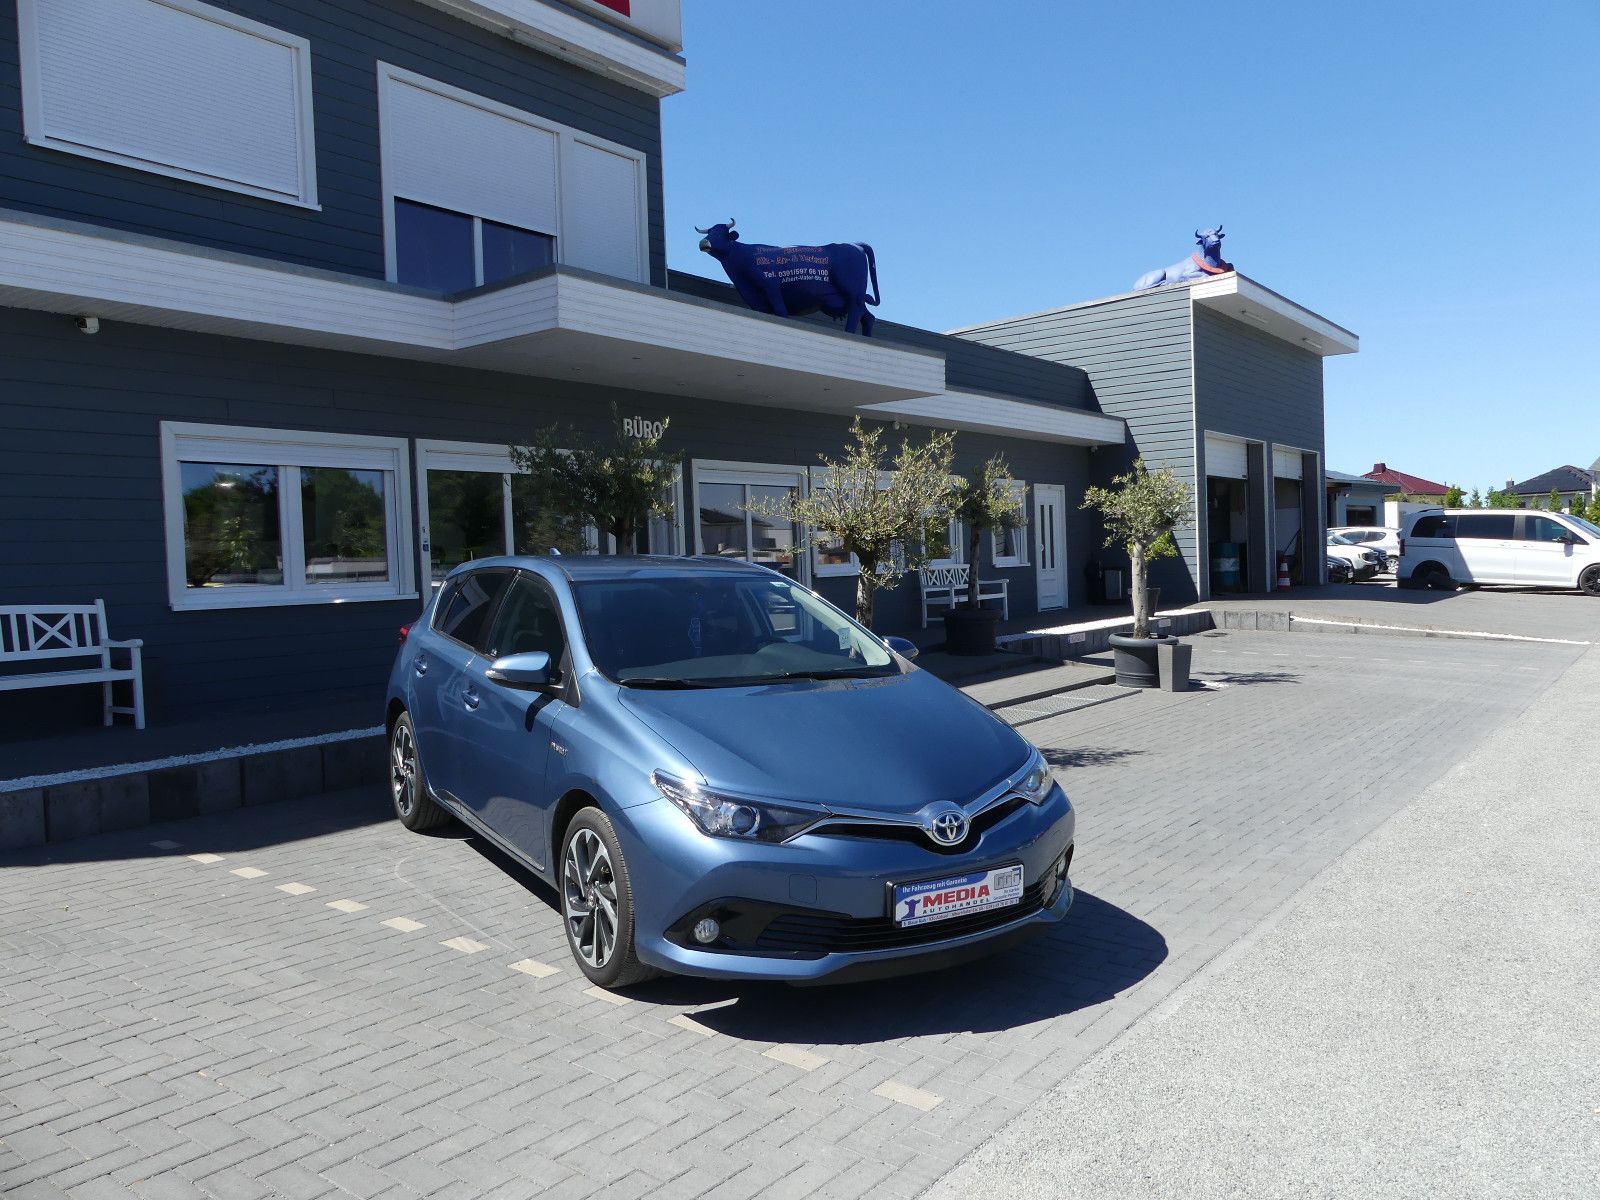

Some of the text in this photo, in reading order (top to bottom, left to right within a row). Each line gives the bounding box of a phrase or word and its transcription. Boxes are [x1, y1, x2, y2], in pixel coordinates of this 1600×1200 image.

[622, 416, 663, 439] BÜRO
[911, 883, 936, 892] Fahrzeug
[945, 877, 967, 886] Garantie
[922, 884, 990, 908] MEDIA
[922, 898, 989, 914] AUTOHANDEL
